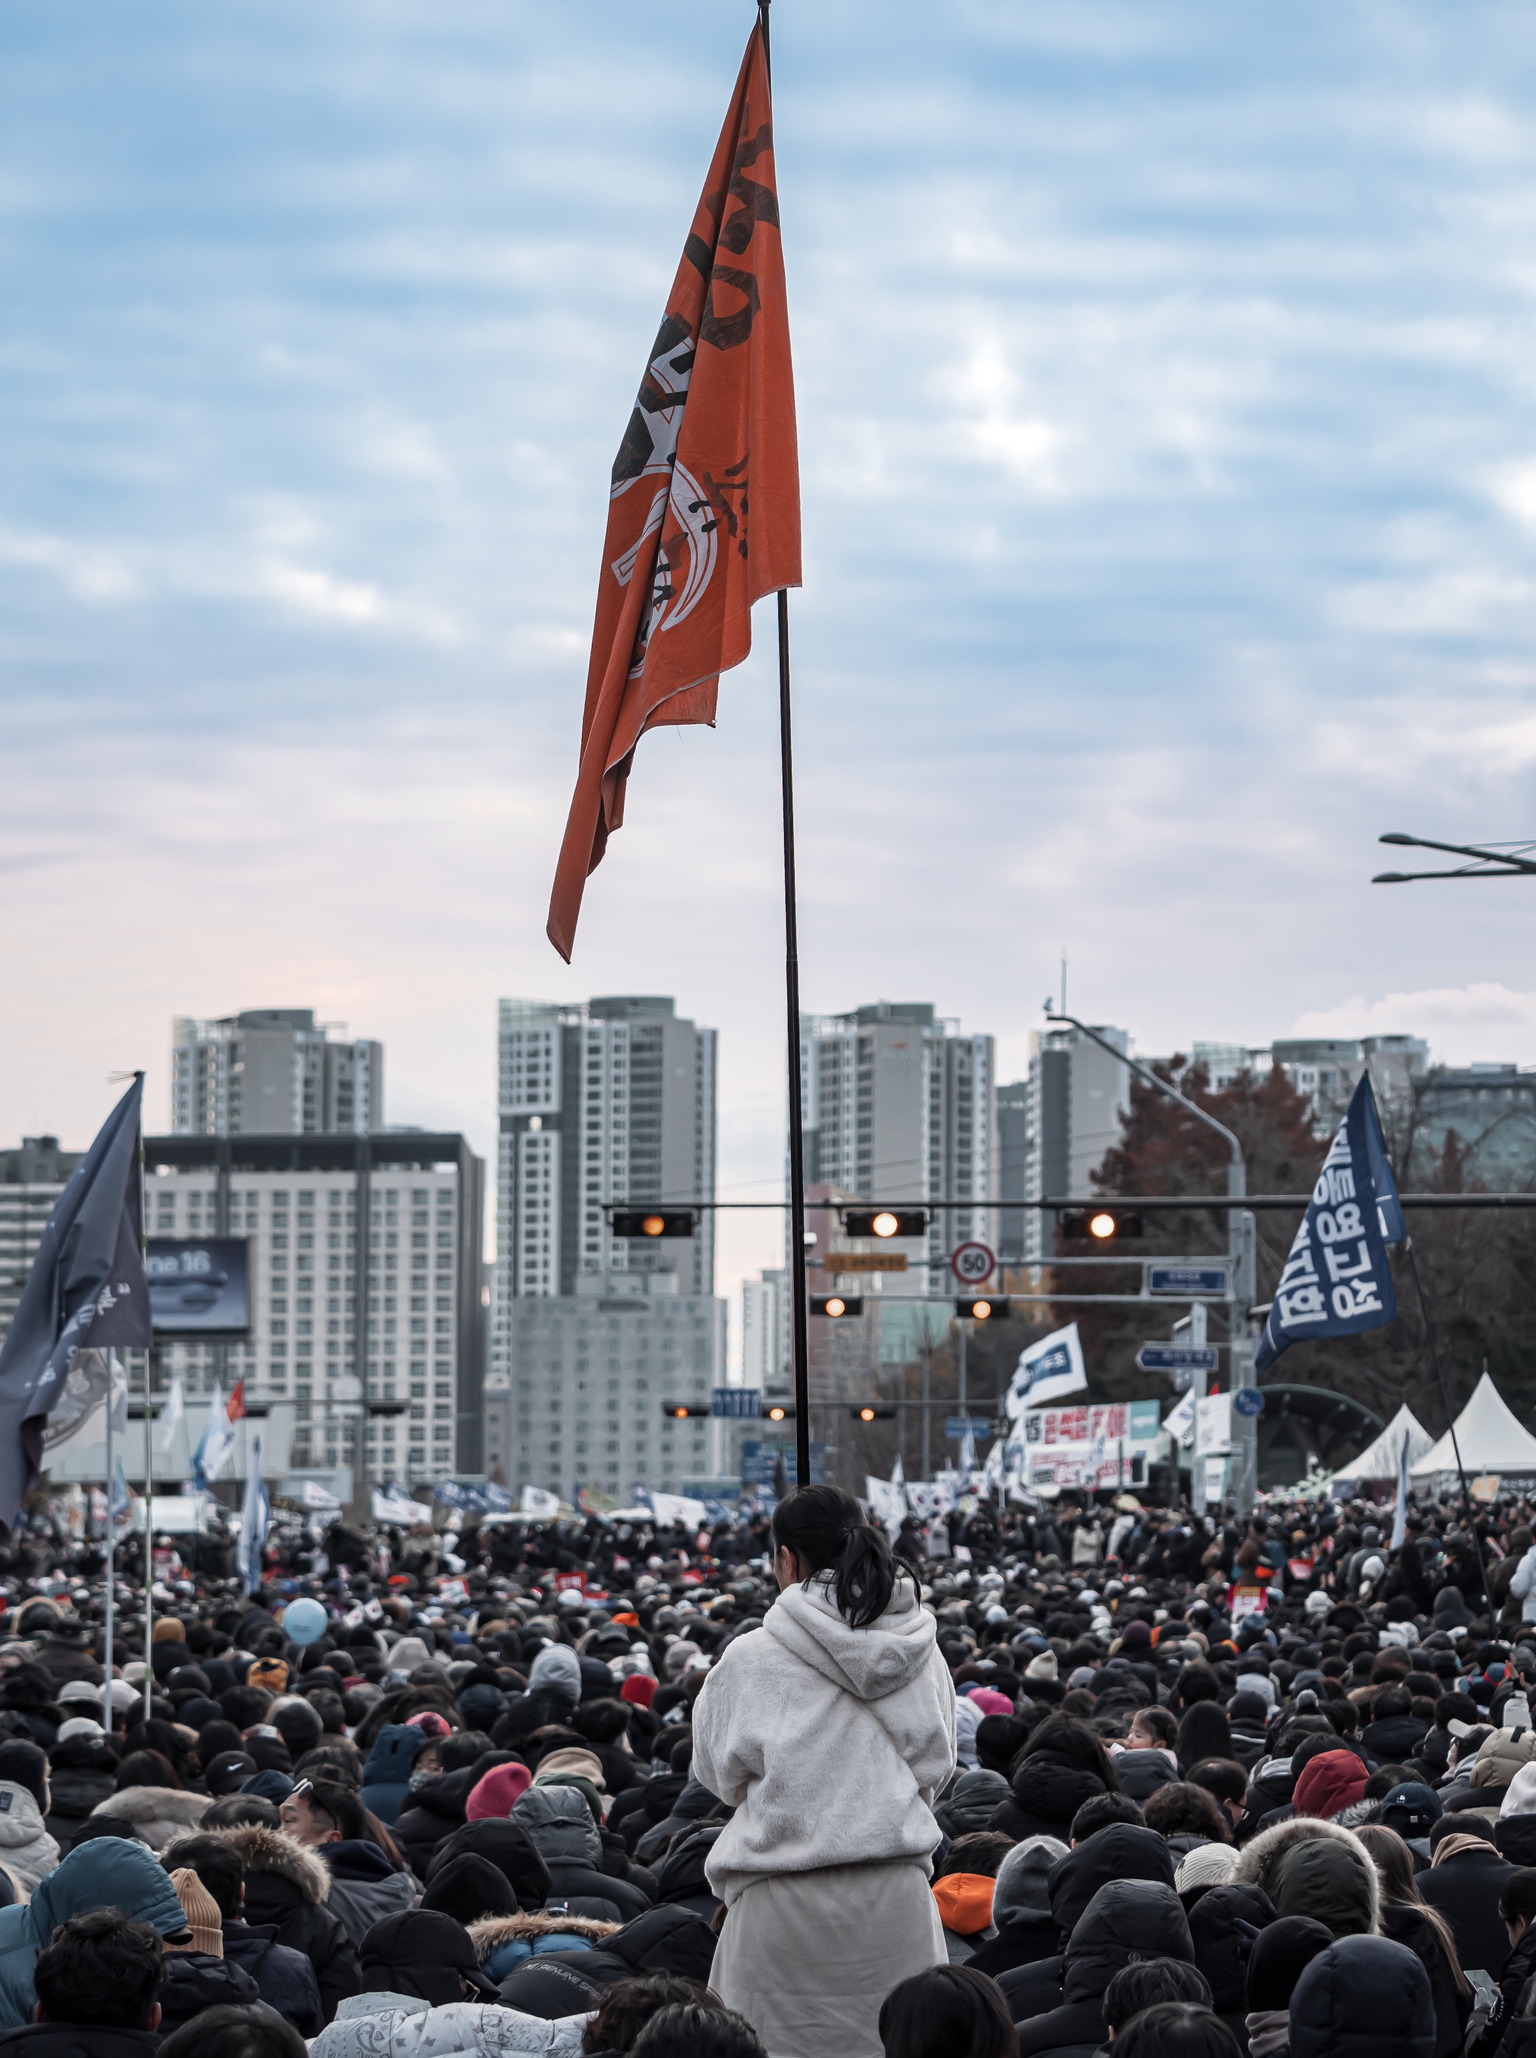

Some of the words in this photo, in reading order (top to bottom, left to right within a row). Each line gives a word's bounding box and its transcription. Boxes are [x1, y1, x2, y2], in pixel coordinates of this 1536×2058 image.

[1312, 1117, 1384, 1319] 제통영고성
[182, 1250, 211, 1273] 16
[961, 1253, 987, 1273] 50
[1274, 1218, 1329, 1329] 지회
[540, 1963, 581, 1984] GENUINE
